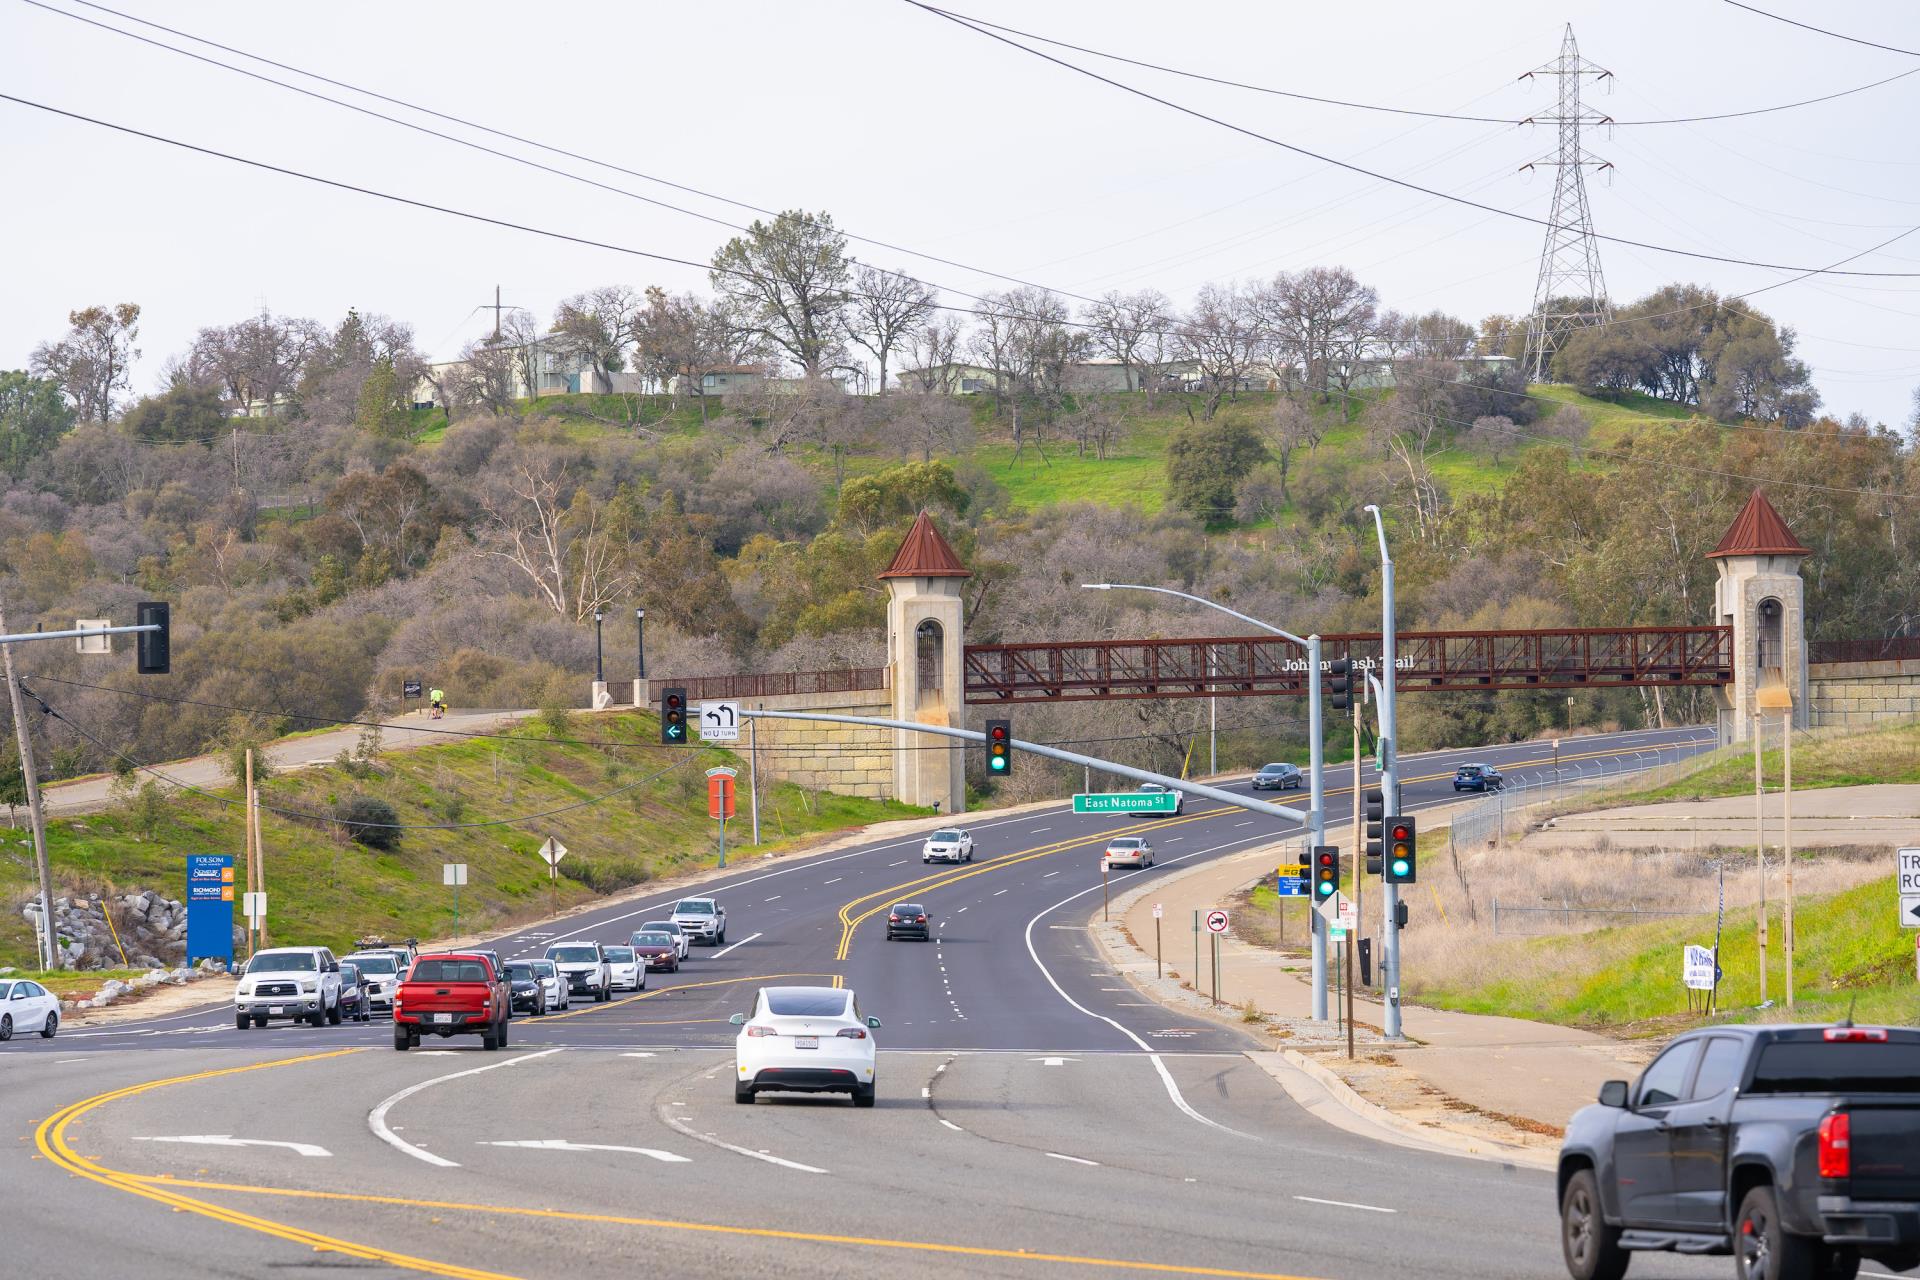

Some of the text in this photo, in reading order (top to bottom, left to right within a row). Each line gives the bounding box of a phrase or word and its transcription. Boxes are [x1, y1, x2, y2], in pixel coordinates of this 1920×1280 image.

[1343, 656, 1376, 669] ash
[713, 730, 720, 738] U
[1085, 796, 1164, 808] East Natoma St
